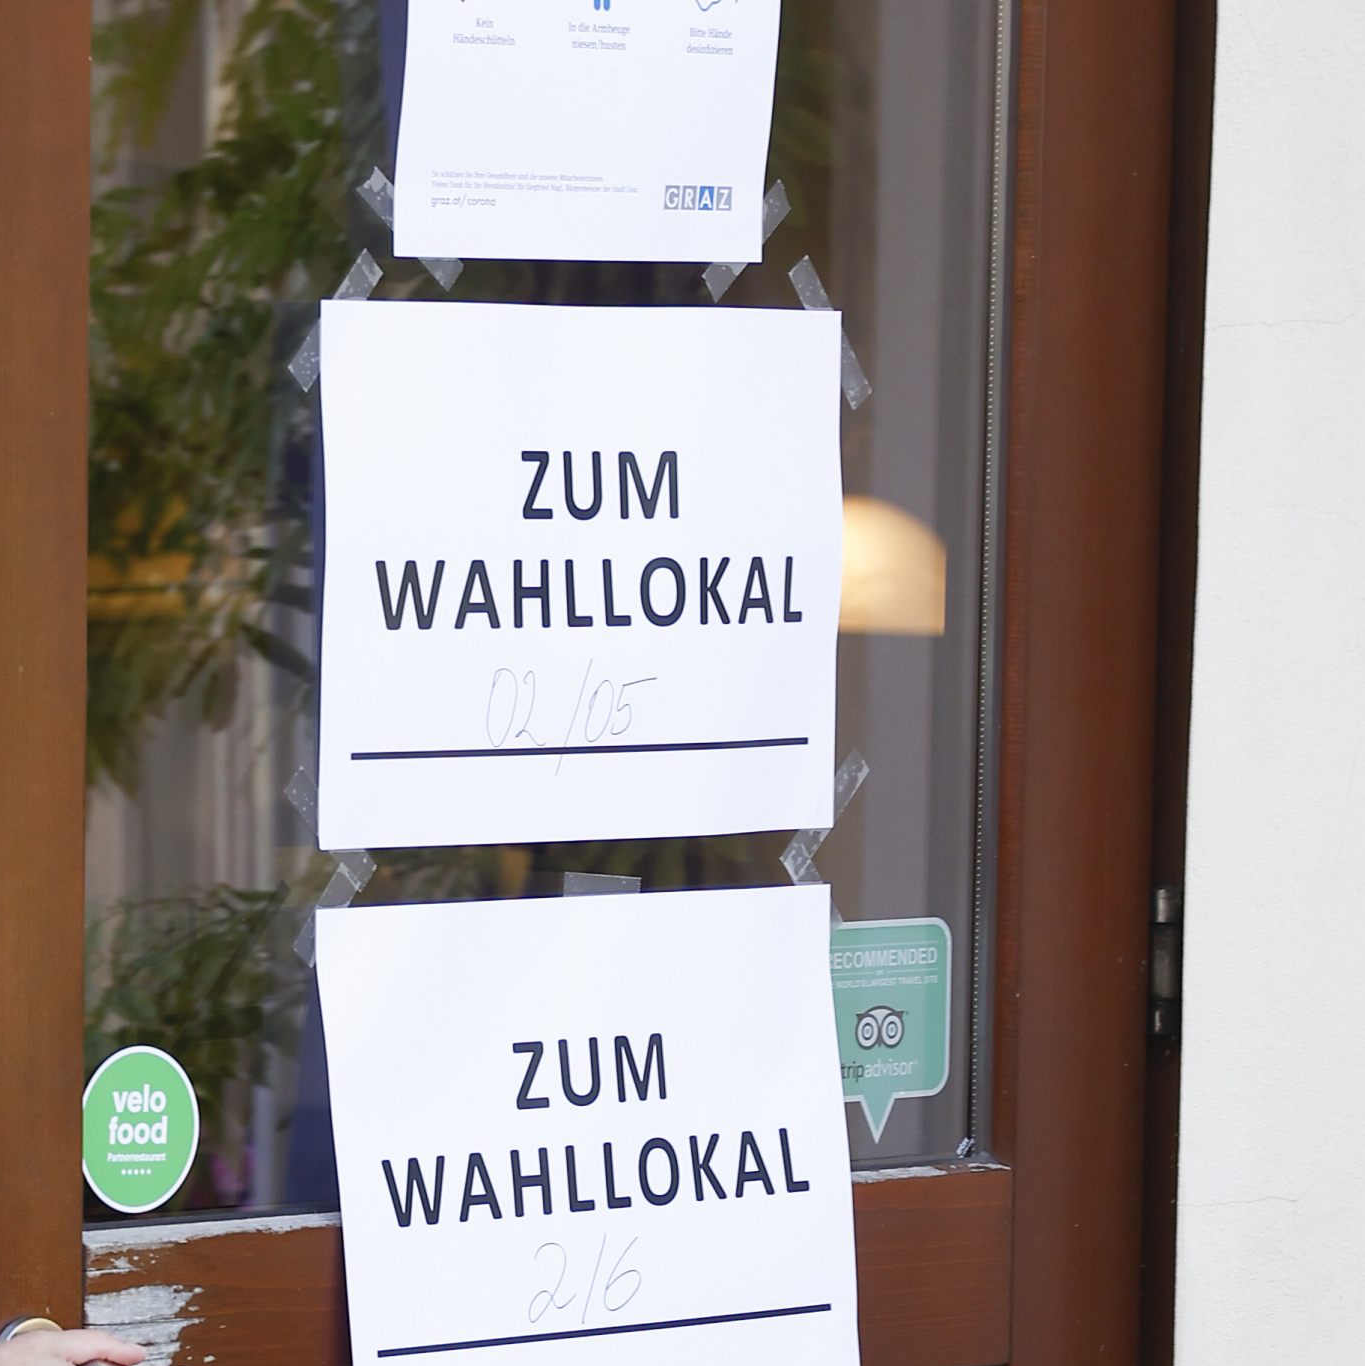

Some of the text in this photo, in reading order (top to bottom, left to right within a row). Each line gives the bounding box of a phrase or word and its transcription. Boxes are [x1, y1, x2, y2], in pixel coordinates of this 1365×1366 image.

[475, 17, 494, 29] Kein
[578, 23, 590, 33] die
[592, 23, 631, 36] Armbeuge
[689, 27, 733, 39] Bitte Hände
[452, 33, 516, 46] Händeschütteln
[666, 186, 731, 210] GRAZ
[521, 450, 680, 521] ZUM
[375, 555, 803, 631] WAHLLOKAL
[512, 1032, 667, 1110] ZUM
[841, 1058, 915, 1083] tripadvisor
[112, 1084, 167, 1113] velo
[109, 1115, 168, 1145] food
[381, 1127, 810, 1228] WAHLLOKAL
